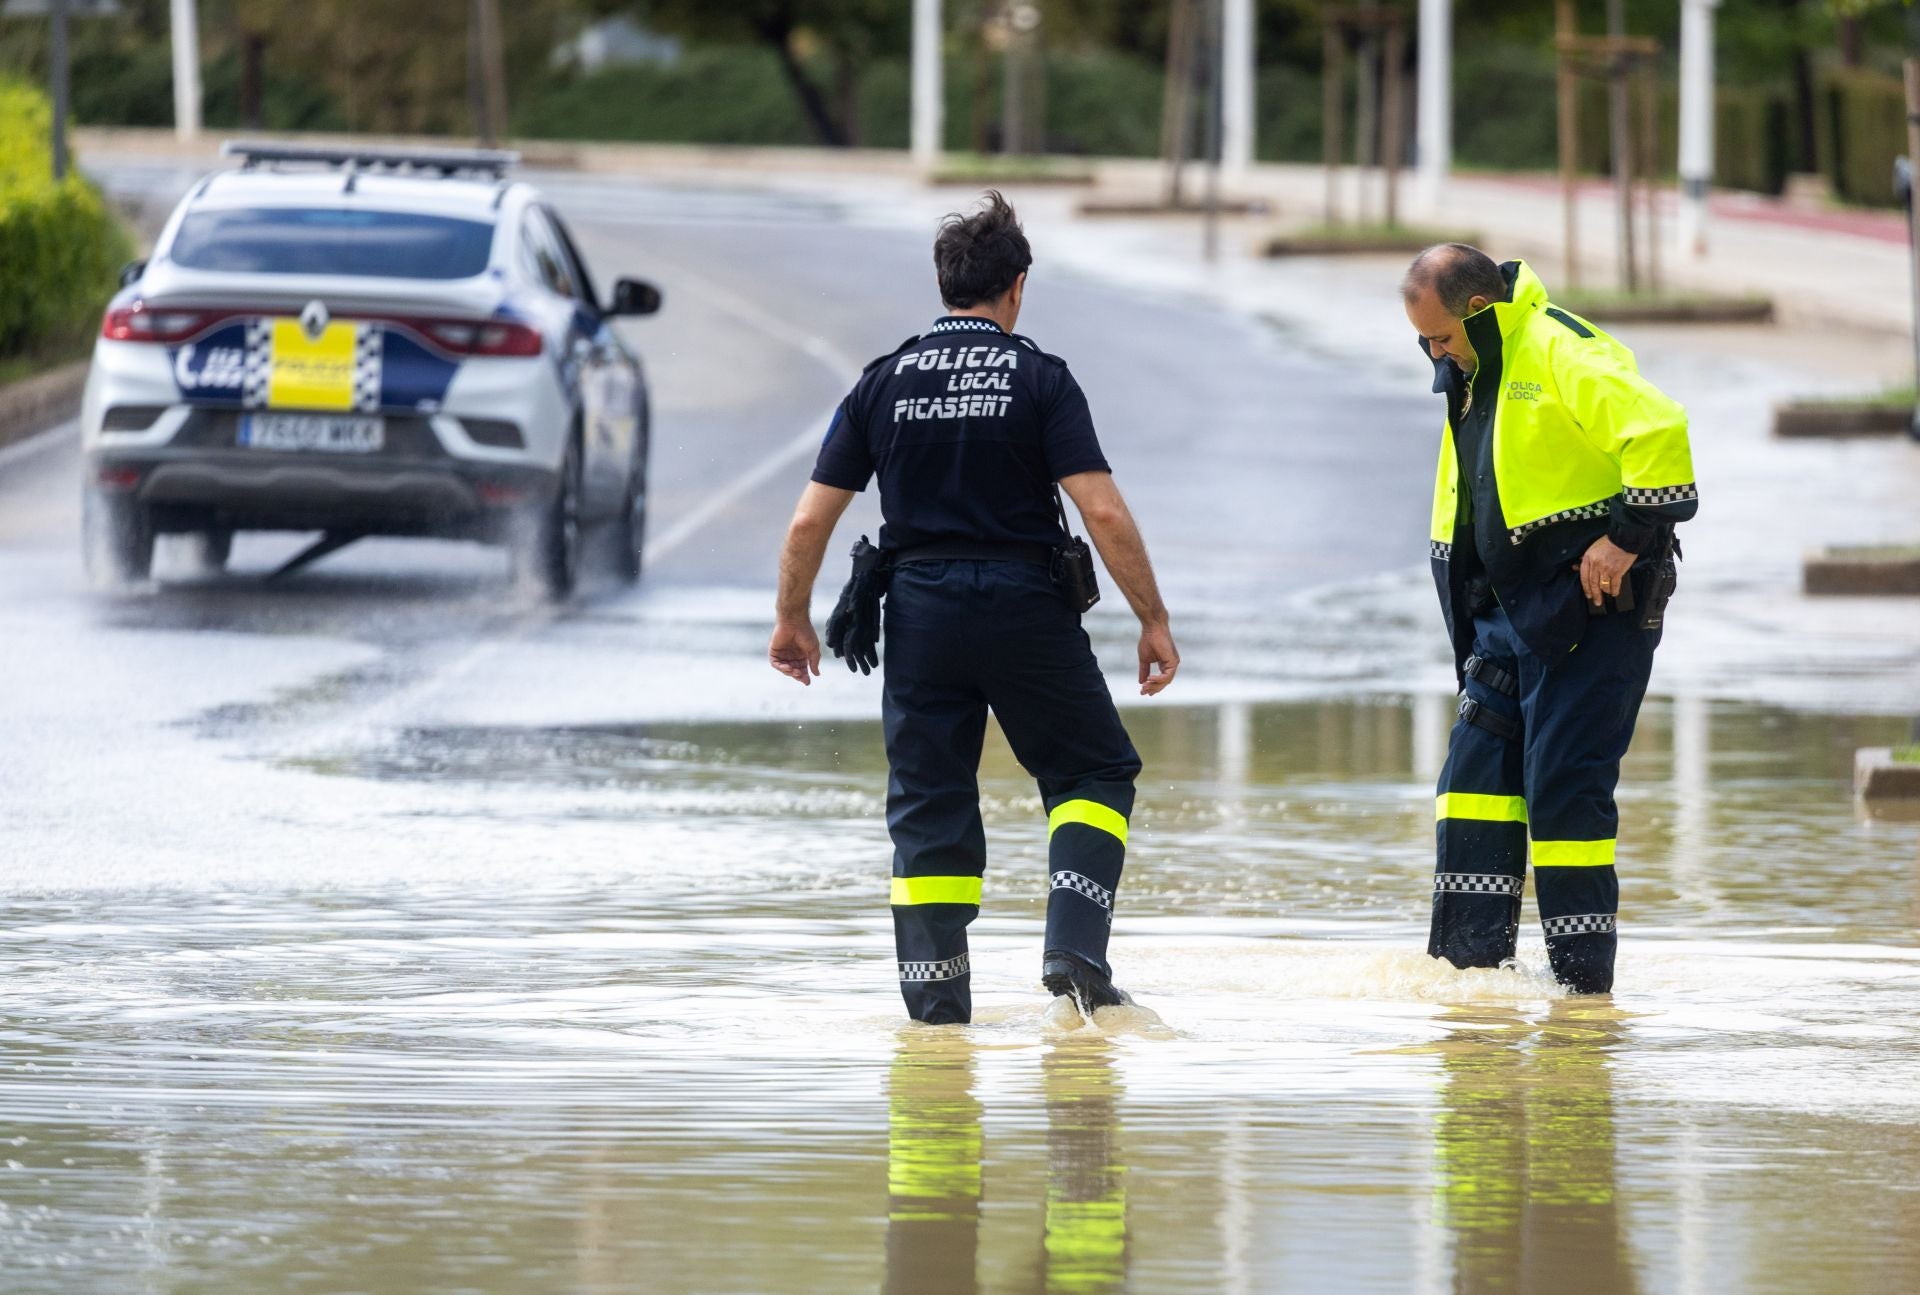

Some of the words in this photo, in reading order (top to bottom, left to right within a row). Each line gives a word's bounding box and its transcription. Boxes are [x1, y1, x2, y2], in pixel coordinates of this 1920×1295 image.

[894, 346, 1017, 375] POLICIA
[947, 372, 1012, 391] LOCAL
[894, 395, 1013, 423] PICASSENT
